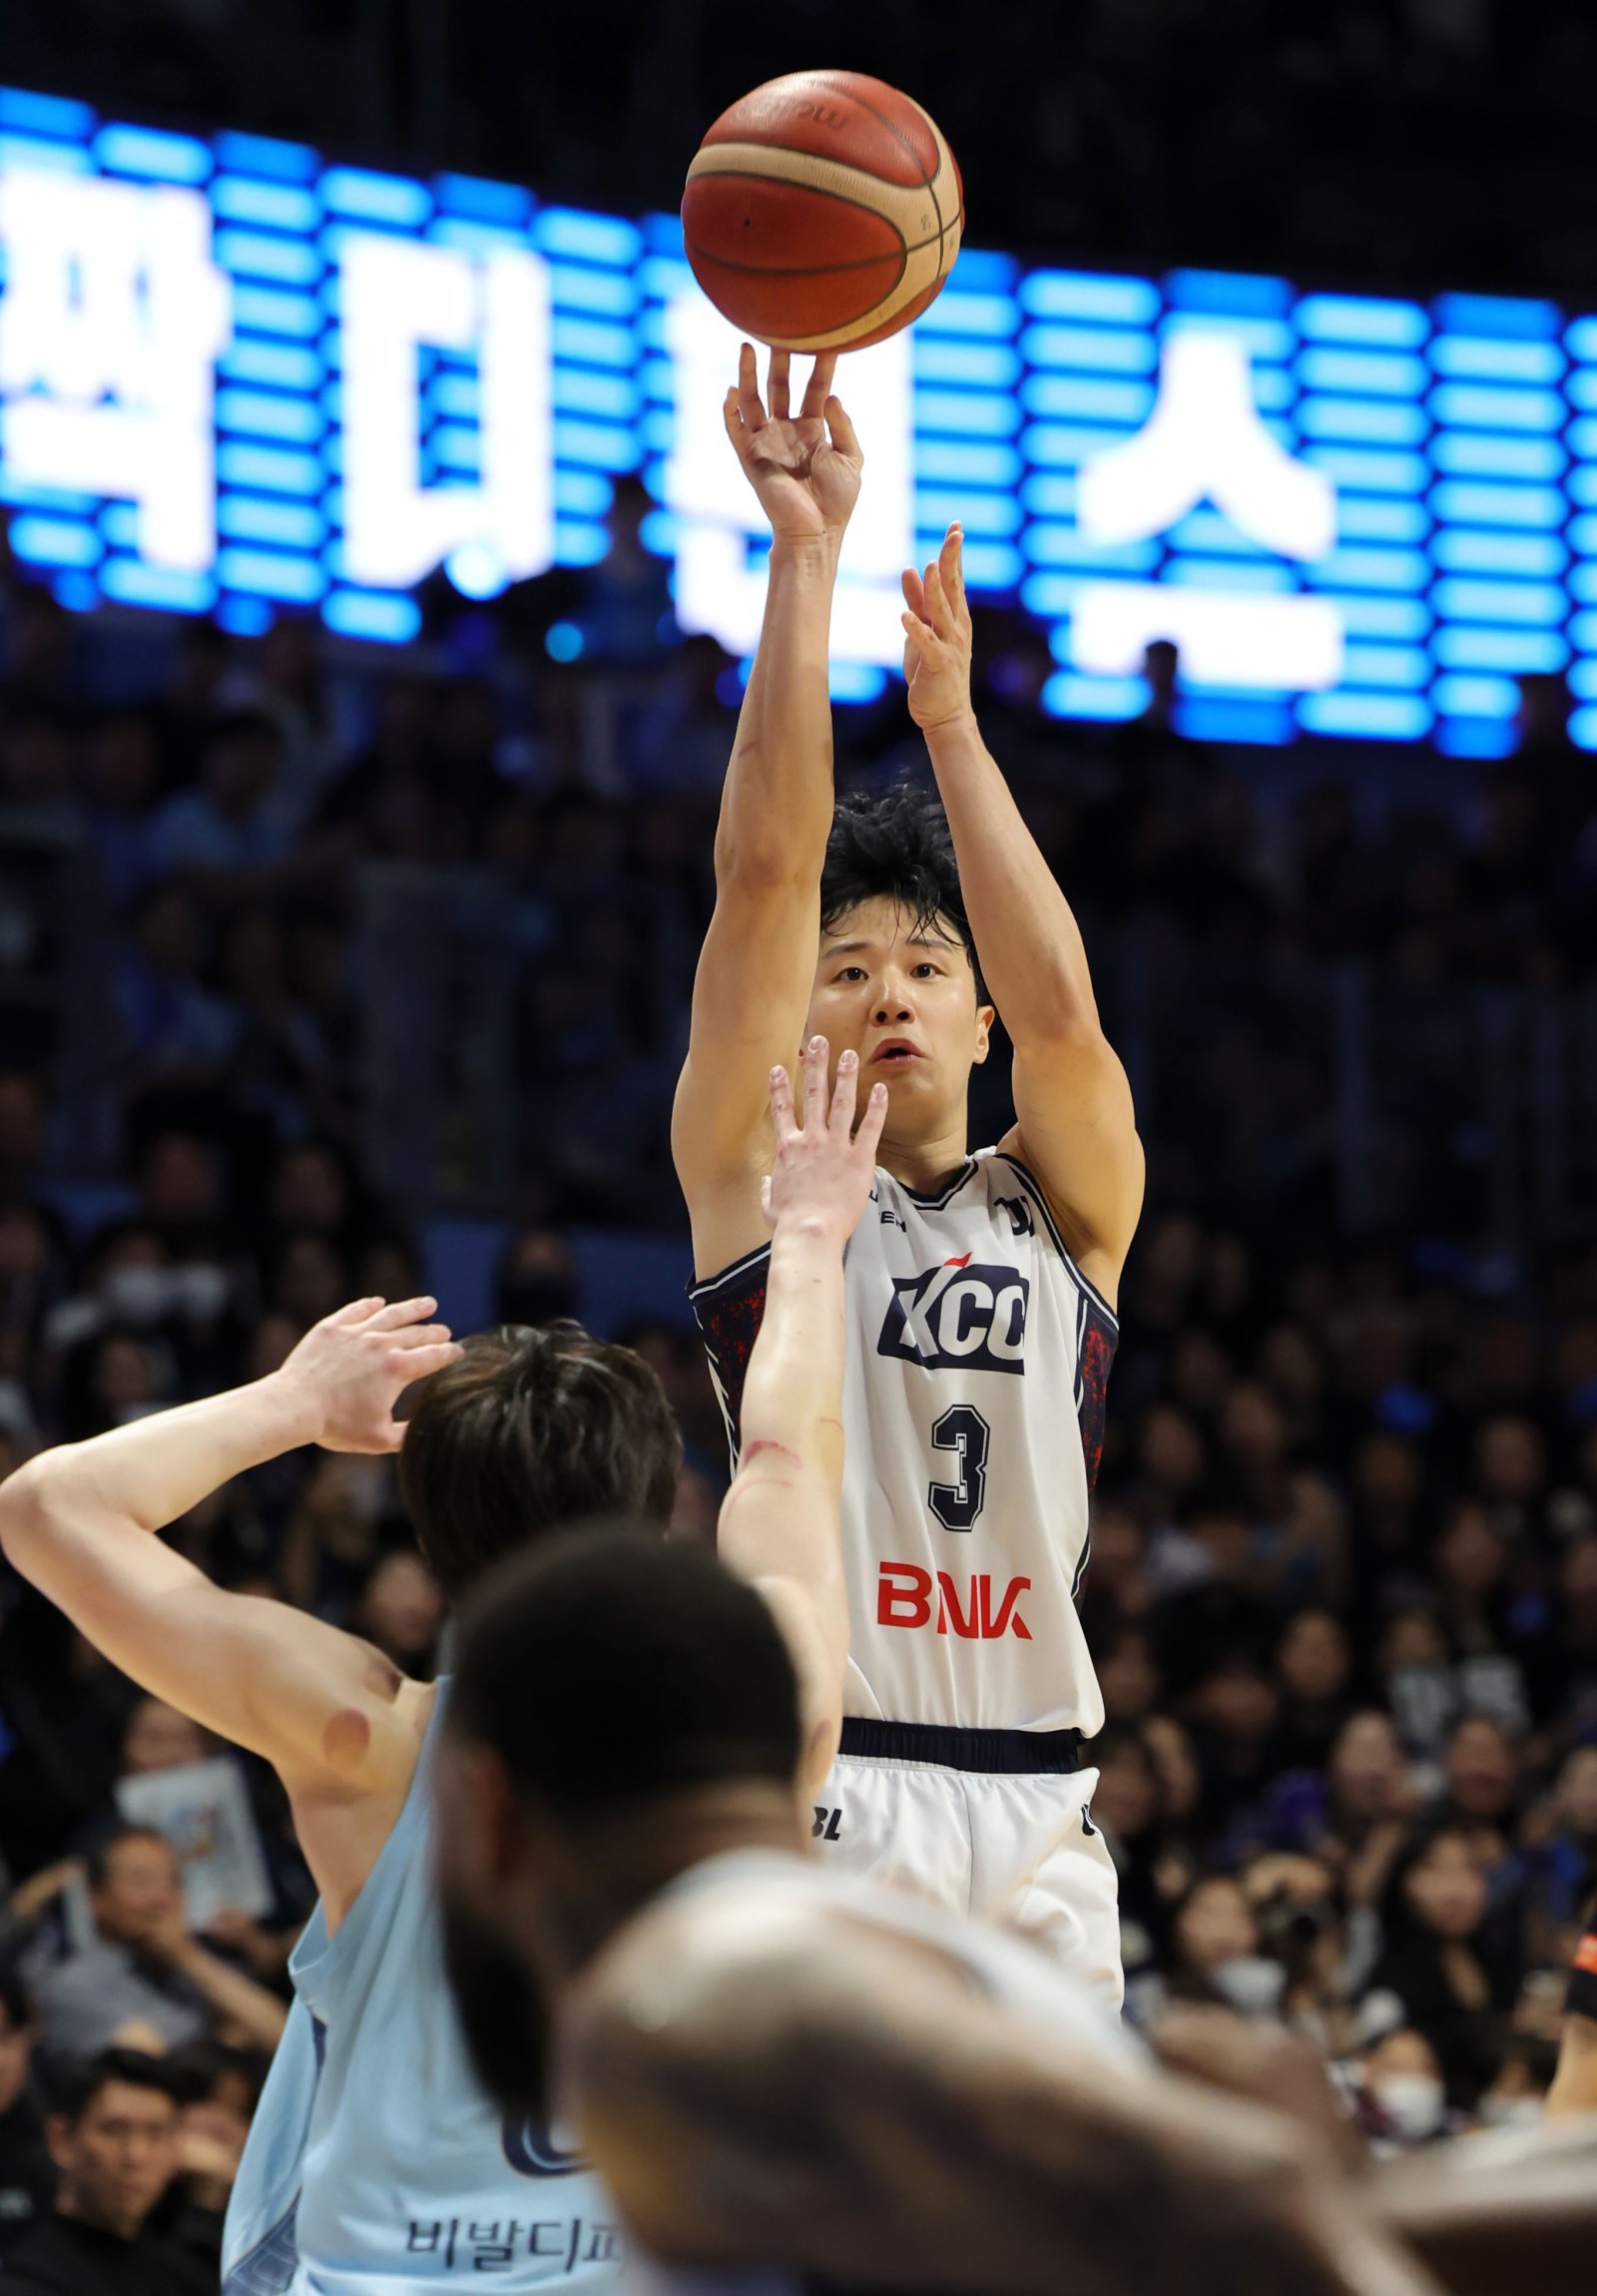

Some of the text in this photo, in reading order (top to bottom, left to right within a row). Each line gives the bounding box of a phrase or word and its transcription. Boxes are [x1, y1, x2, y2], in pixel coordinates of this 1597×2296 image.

[742, 97, 850, 133] molt
[896, 1265, 1027, 1362] KCC
[928, 1404, 991, 1533] 3
[876, 1560, 1034, 1640] BNK
